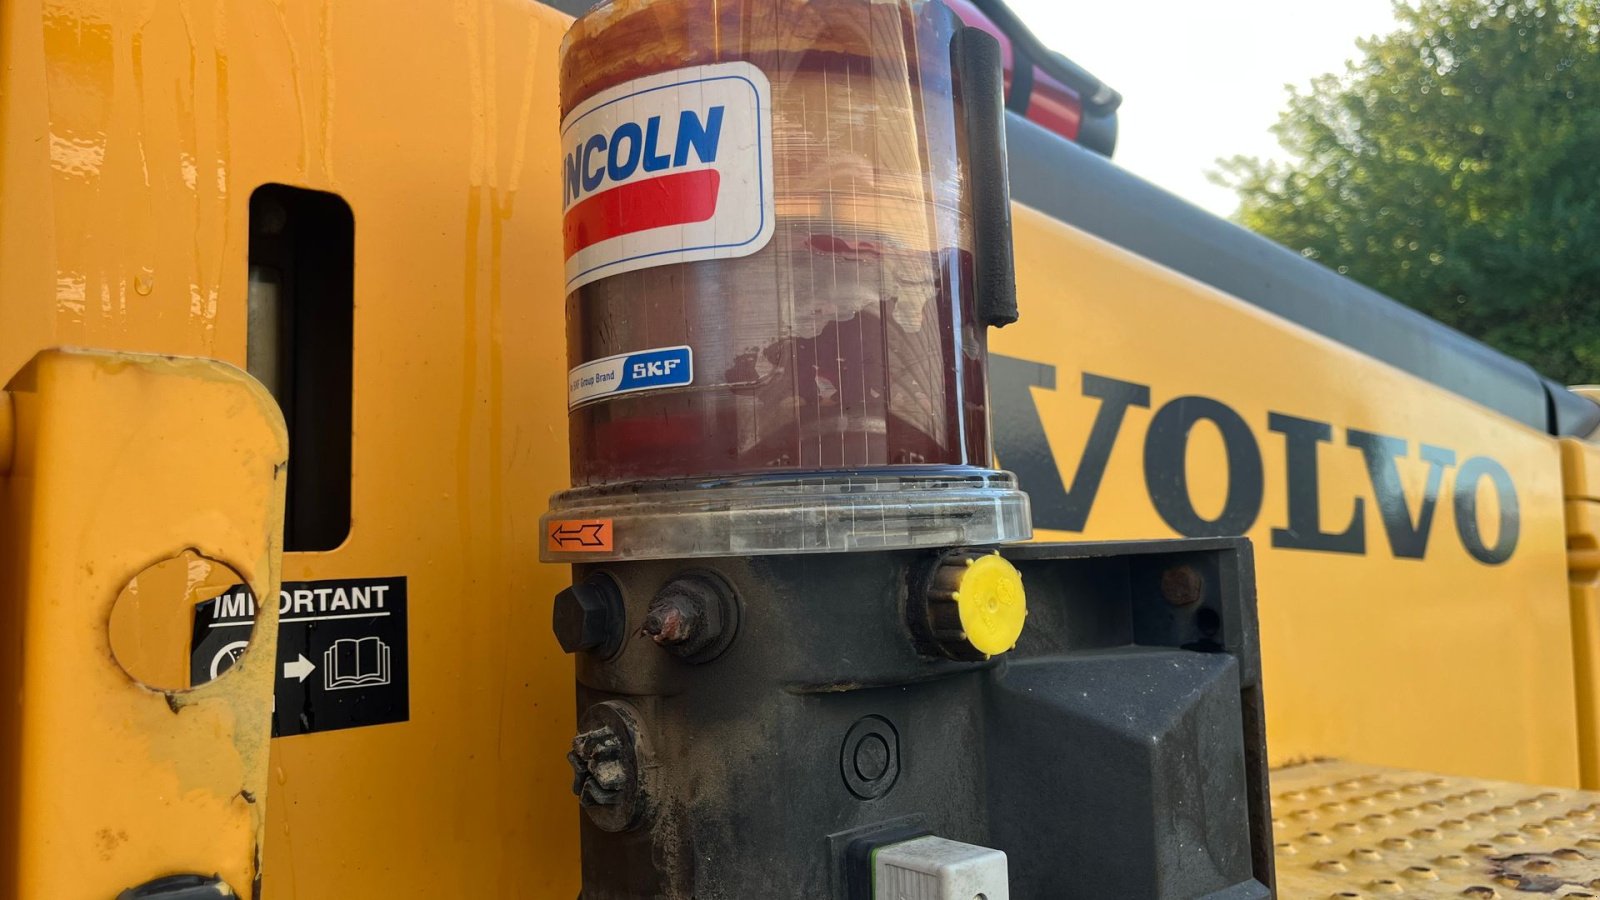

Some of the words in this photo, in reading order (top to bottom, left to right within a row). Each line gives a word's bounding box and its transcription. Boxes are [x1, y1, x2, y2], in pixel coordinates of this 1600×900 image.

[581, 377, 594, 388] Group
[596, 370, 615, 383] Brand
[632, 359, 681, 379] SKF
[986, 352, 1520, 567] VOLVO
